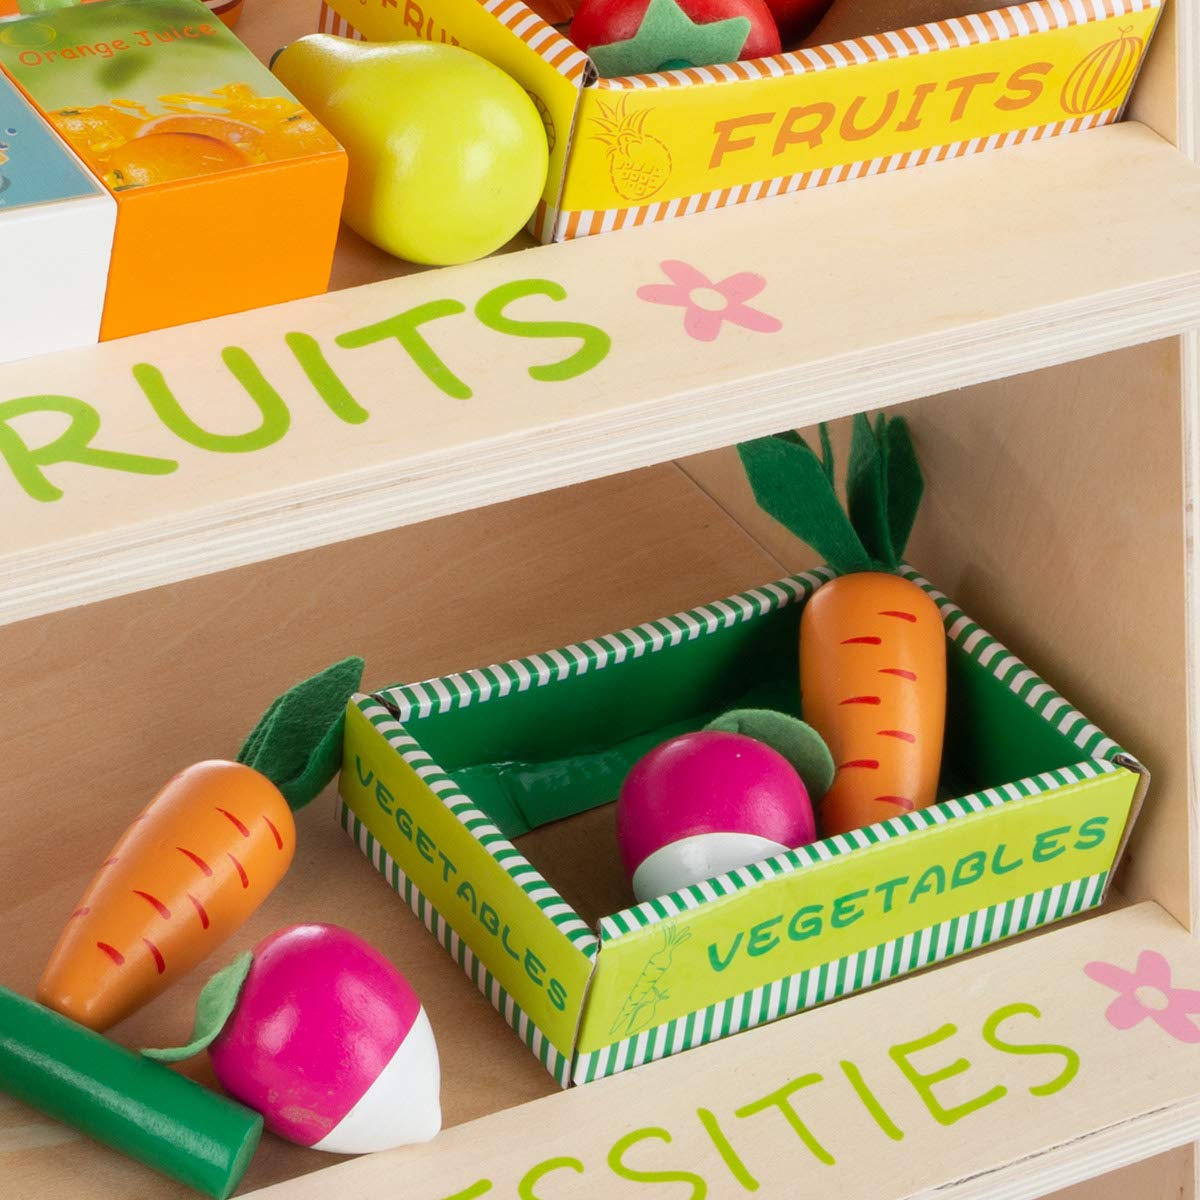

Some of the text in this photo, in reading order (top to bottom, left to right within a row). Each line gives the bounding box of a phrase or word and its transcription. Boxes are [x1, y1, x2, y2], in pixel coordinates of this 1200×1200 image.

[19, 24, 218, 66] Orange Juice
[709, 62, 1055, 170] FRUITS
[355, 754, 567, 1011] VEGETABLES
[708, 816, 1110, 972] VEGETABLES
[440, 1002, 1082, 1200] SITIES
